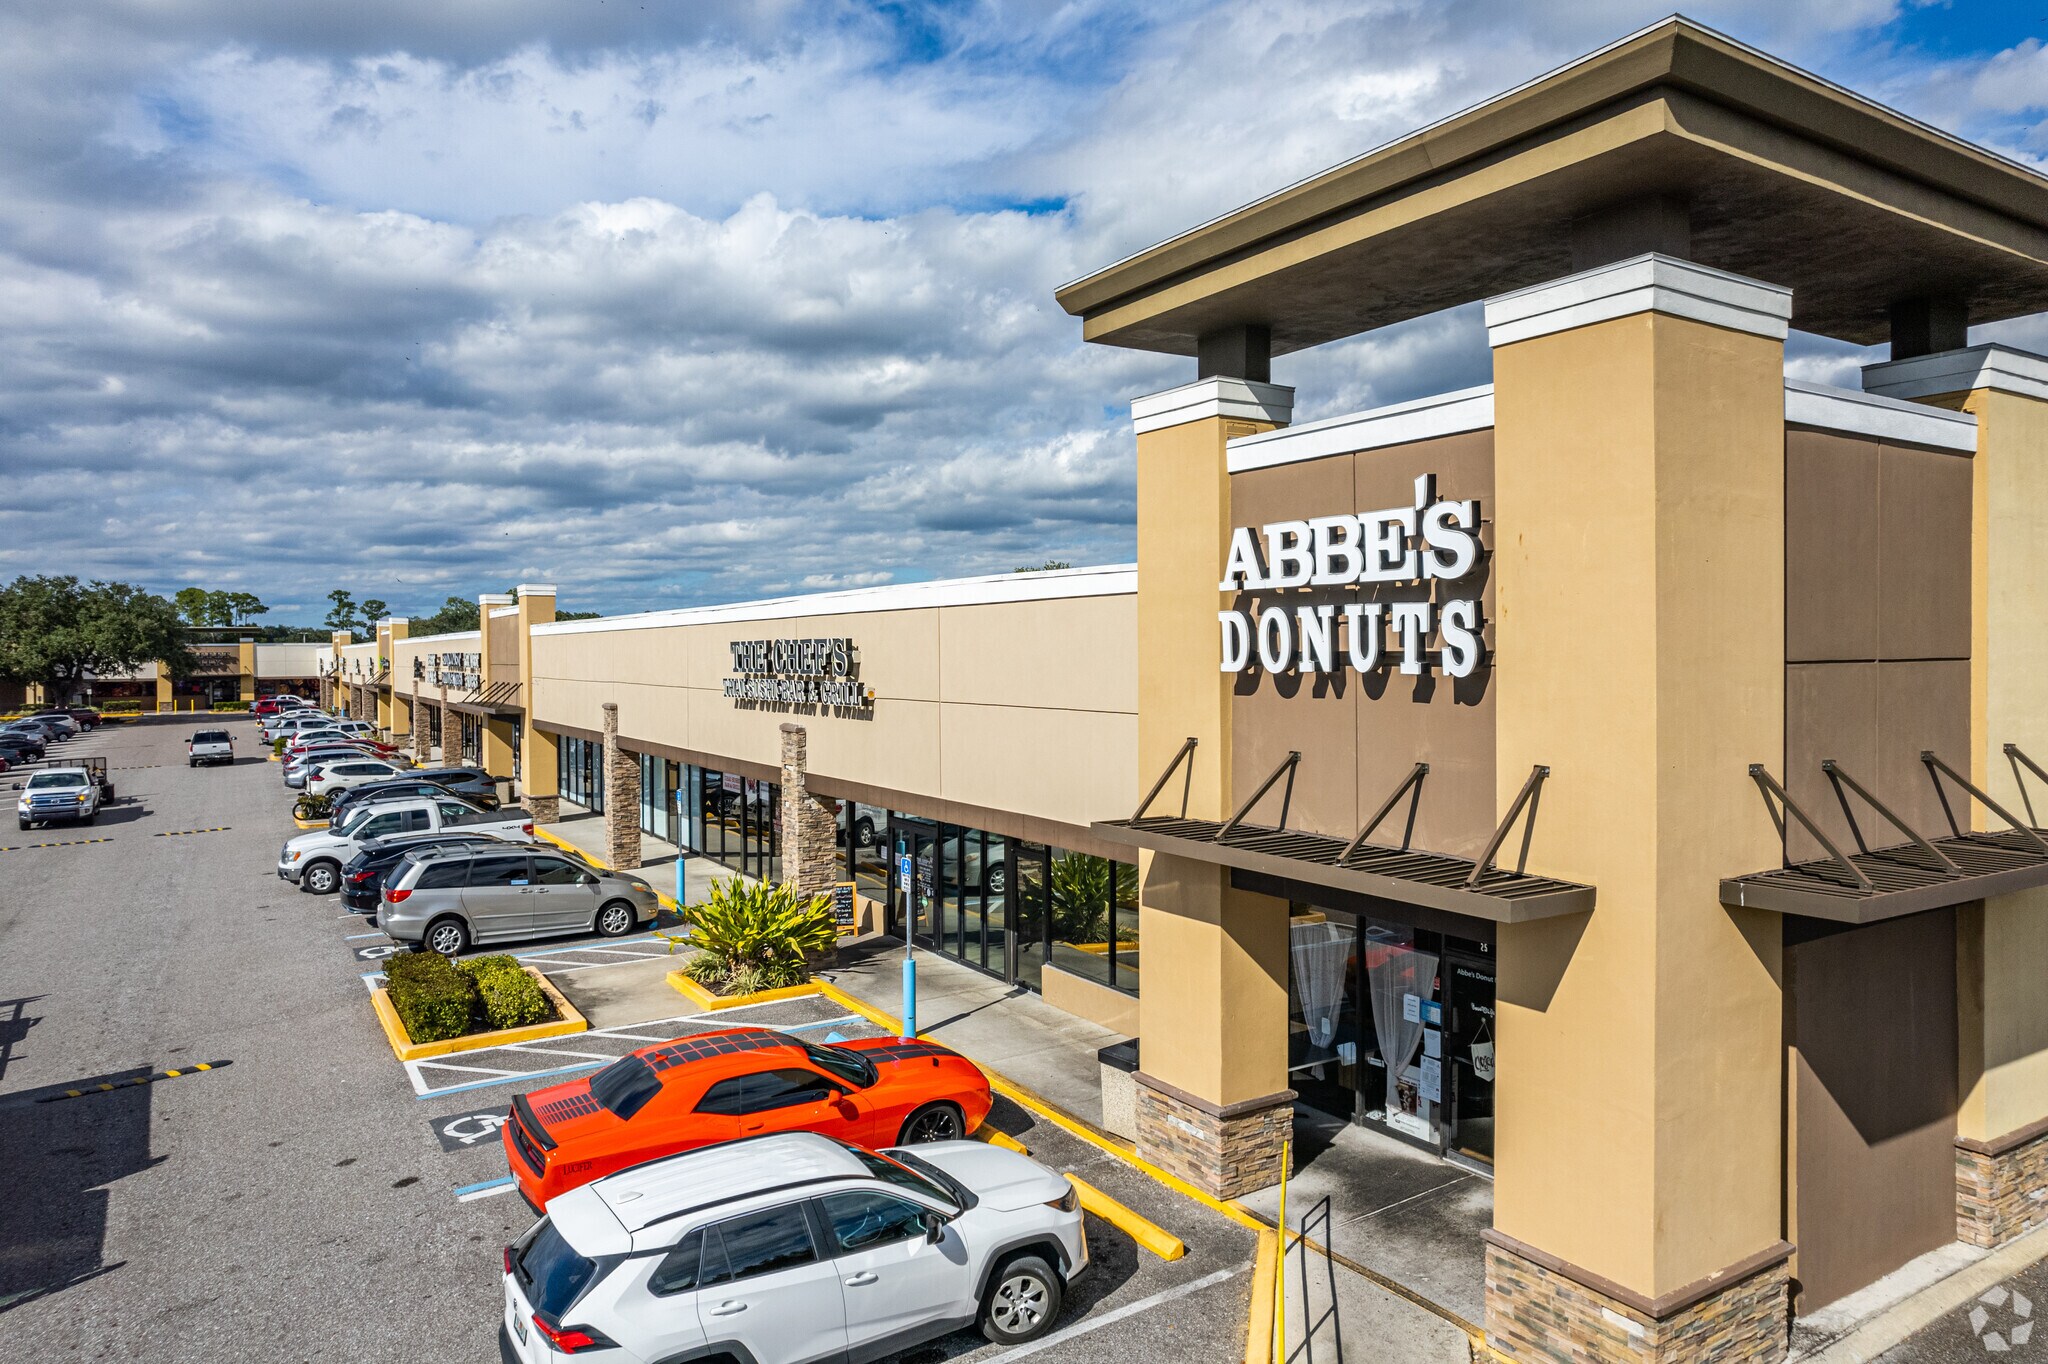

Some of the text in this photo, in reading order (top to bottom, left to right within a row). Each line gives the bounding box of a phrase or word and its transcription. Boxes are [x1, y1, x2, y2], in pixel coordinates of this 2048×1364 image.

[1219, 473, 1478, 591] ABBE'S
[1218, 600, 1478, 678] DONUTS
[730, 638, 849, 677] THE CHEF'S
[820, 682, 862, 707] GRILL
[1480, 943, 1488, 953] 25
[1457, 968, 1475, 979] Abbe's
[563, 1161, 593, 1175] LUCIFER
